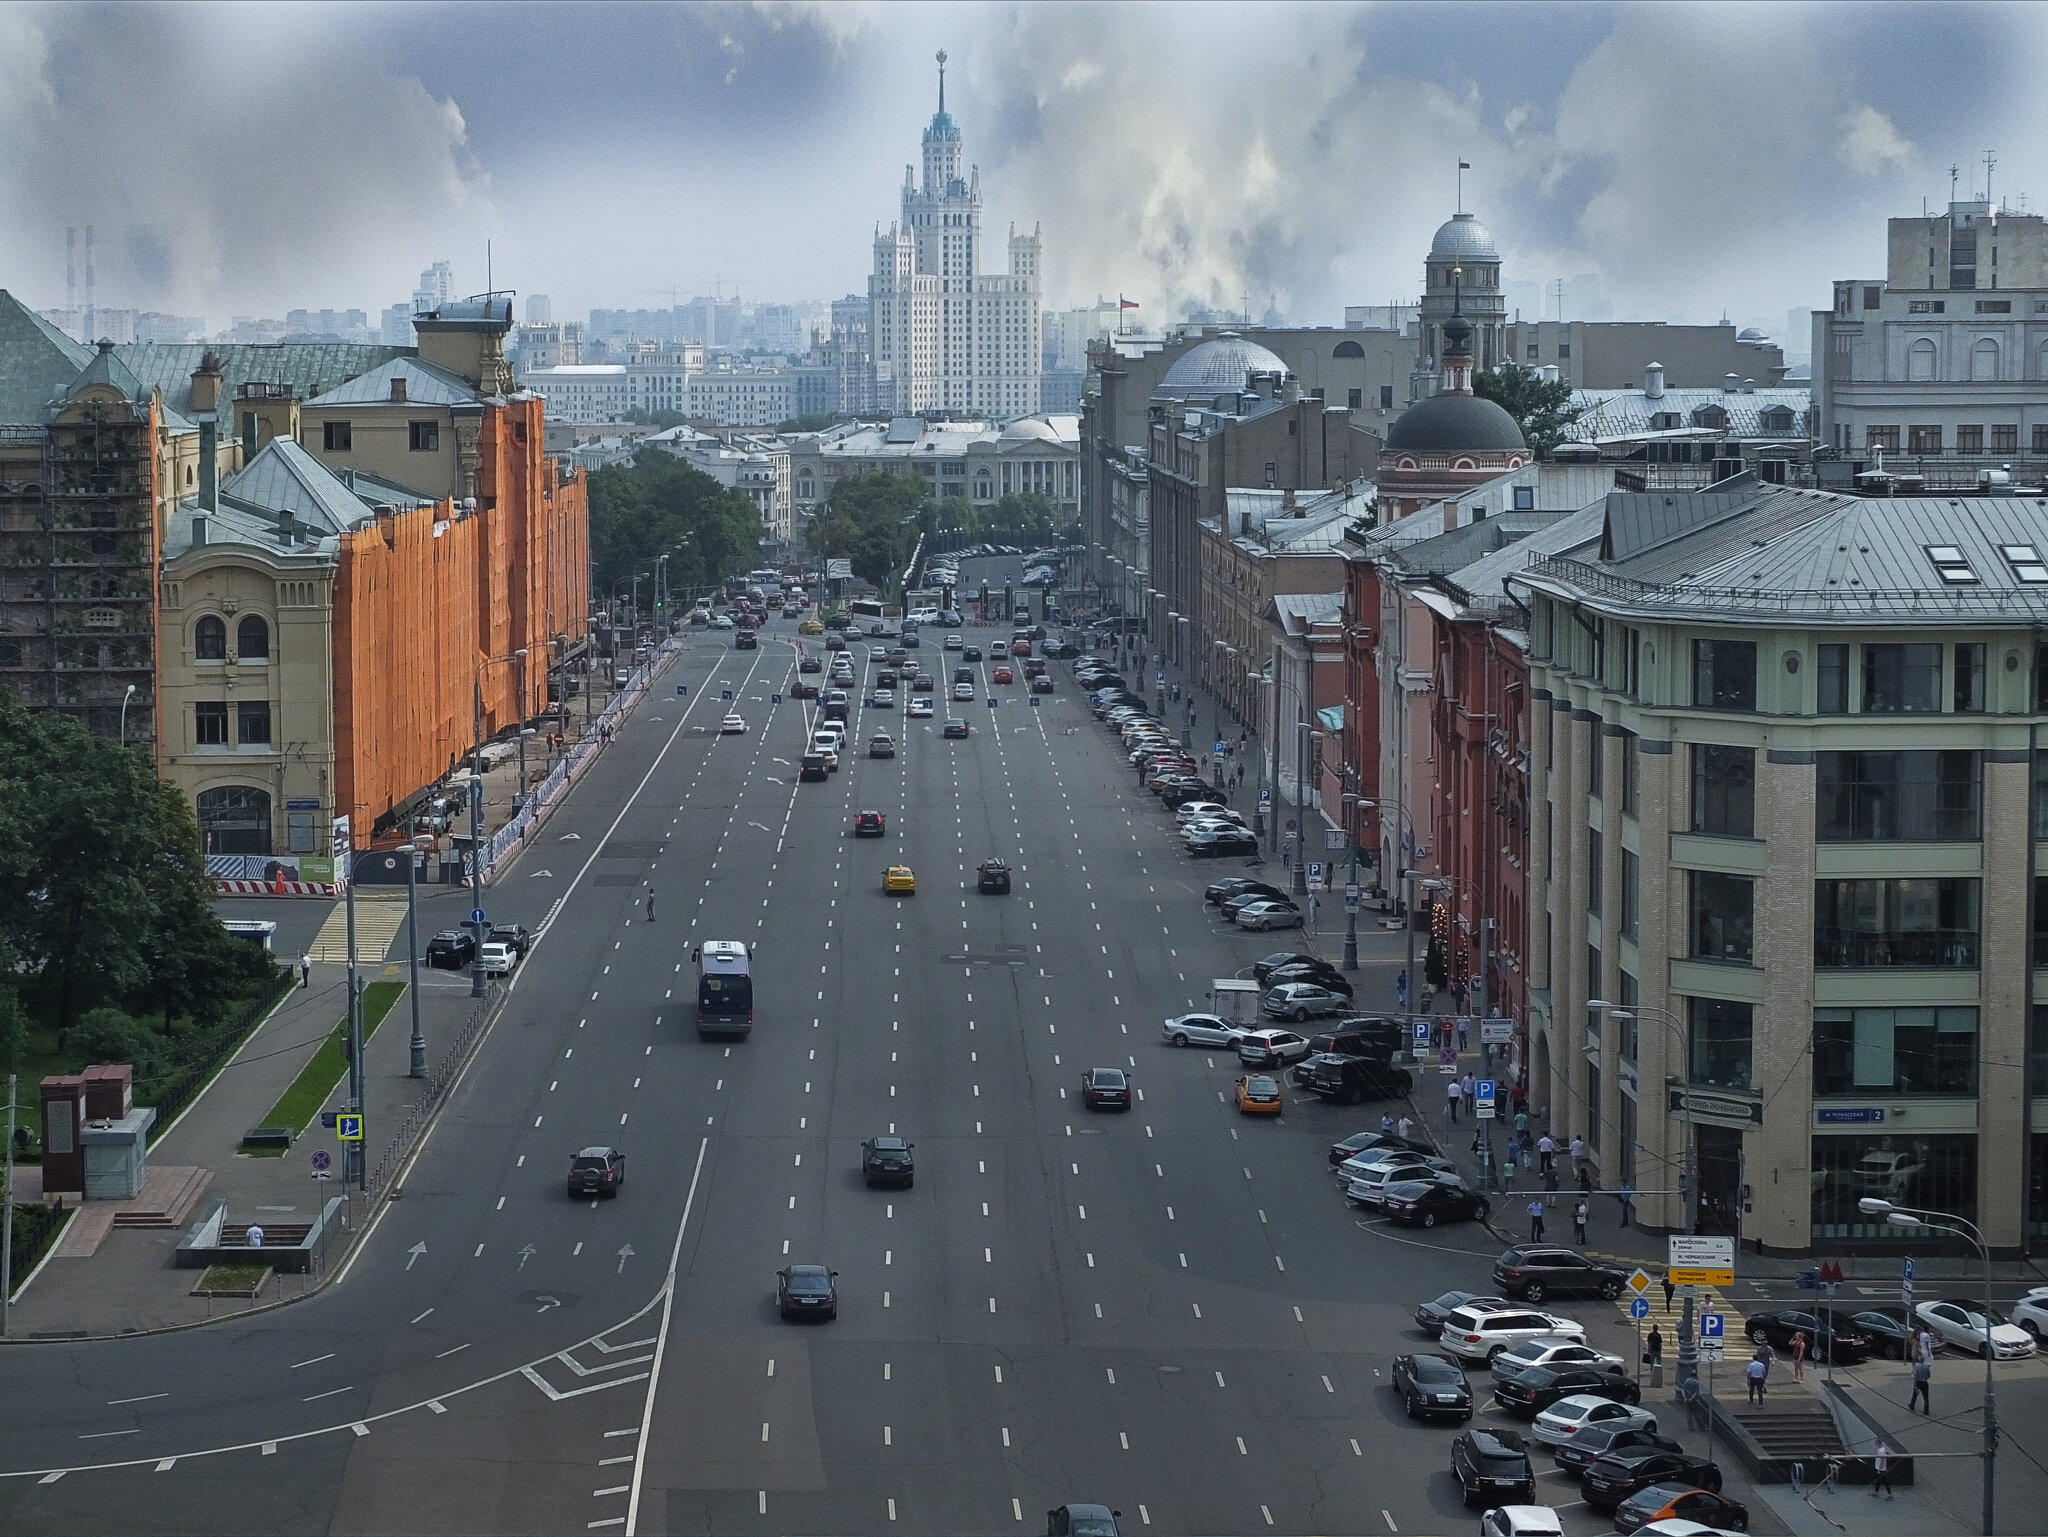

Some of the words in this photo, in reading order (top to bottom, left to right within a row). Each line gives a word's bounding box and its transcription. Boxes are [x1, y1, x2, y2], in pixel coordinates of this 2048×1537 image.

[1261, 790, 1268, 799] P
[1311, 864, 1319, 875] P
[1416, 1024, 1426, 1038] P
[1480, 1082, 1490, 1097] P
[1874, 1110, 1881, 1120] 2
[1905, 1260, 1912, 1277] P
[1706, 1316, 1719, 1335] P
